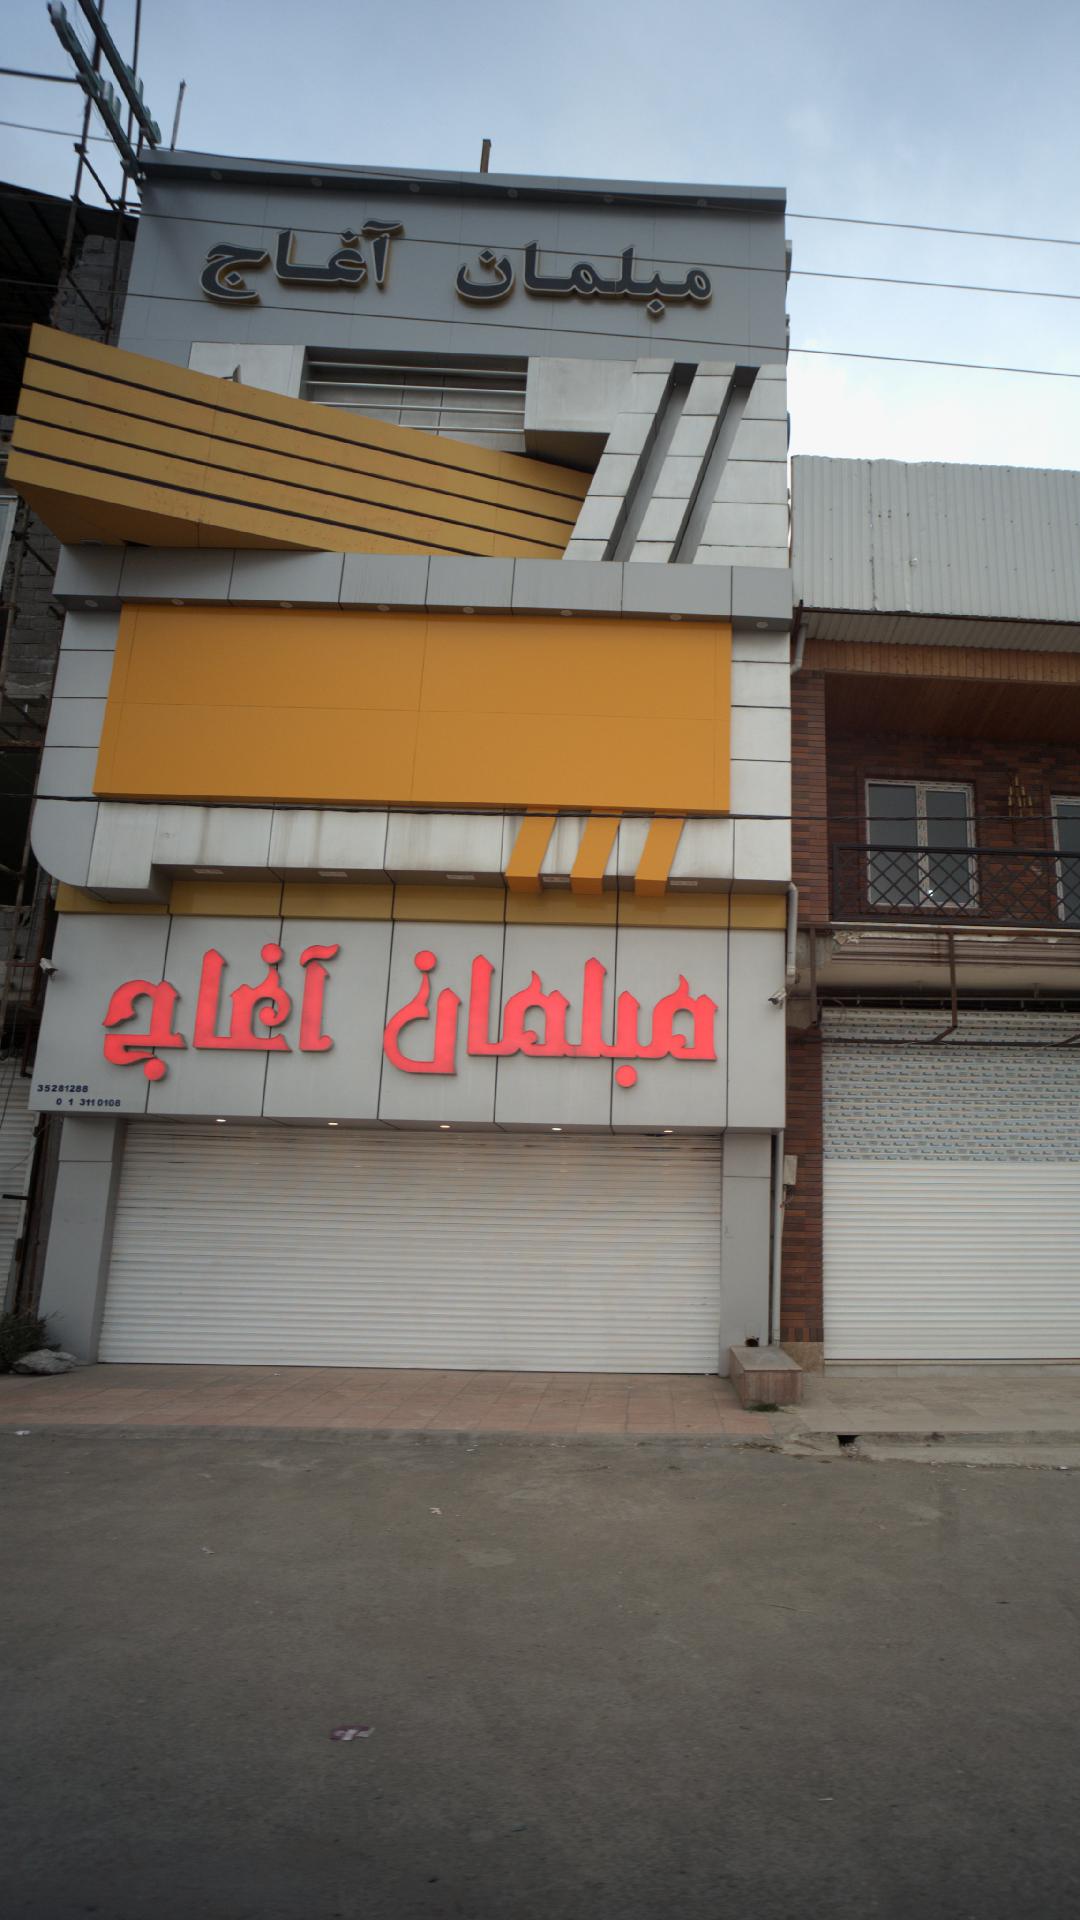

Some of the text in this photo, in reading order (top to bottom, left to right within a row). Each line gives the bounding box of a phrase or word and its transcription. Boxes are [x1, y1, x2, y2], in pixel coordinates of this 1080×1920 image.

[200, 218, 713, 318] مبلمان آغاج
[383, 950, 719, 1089] مبلمان
